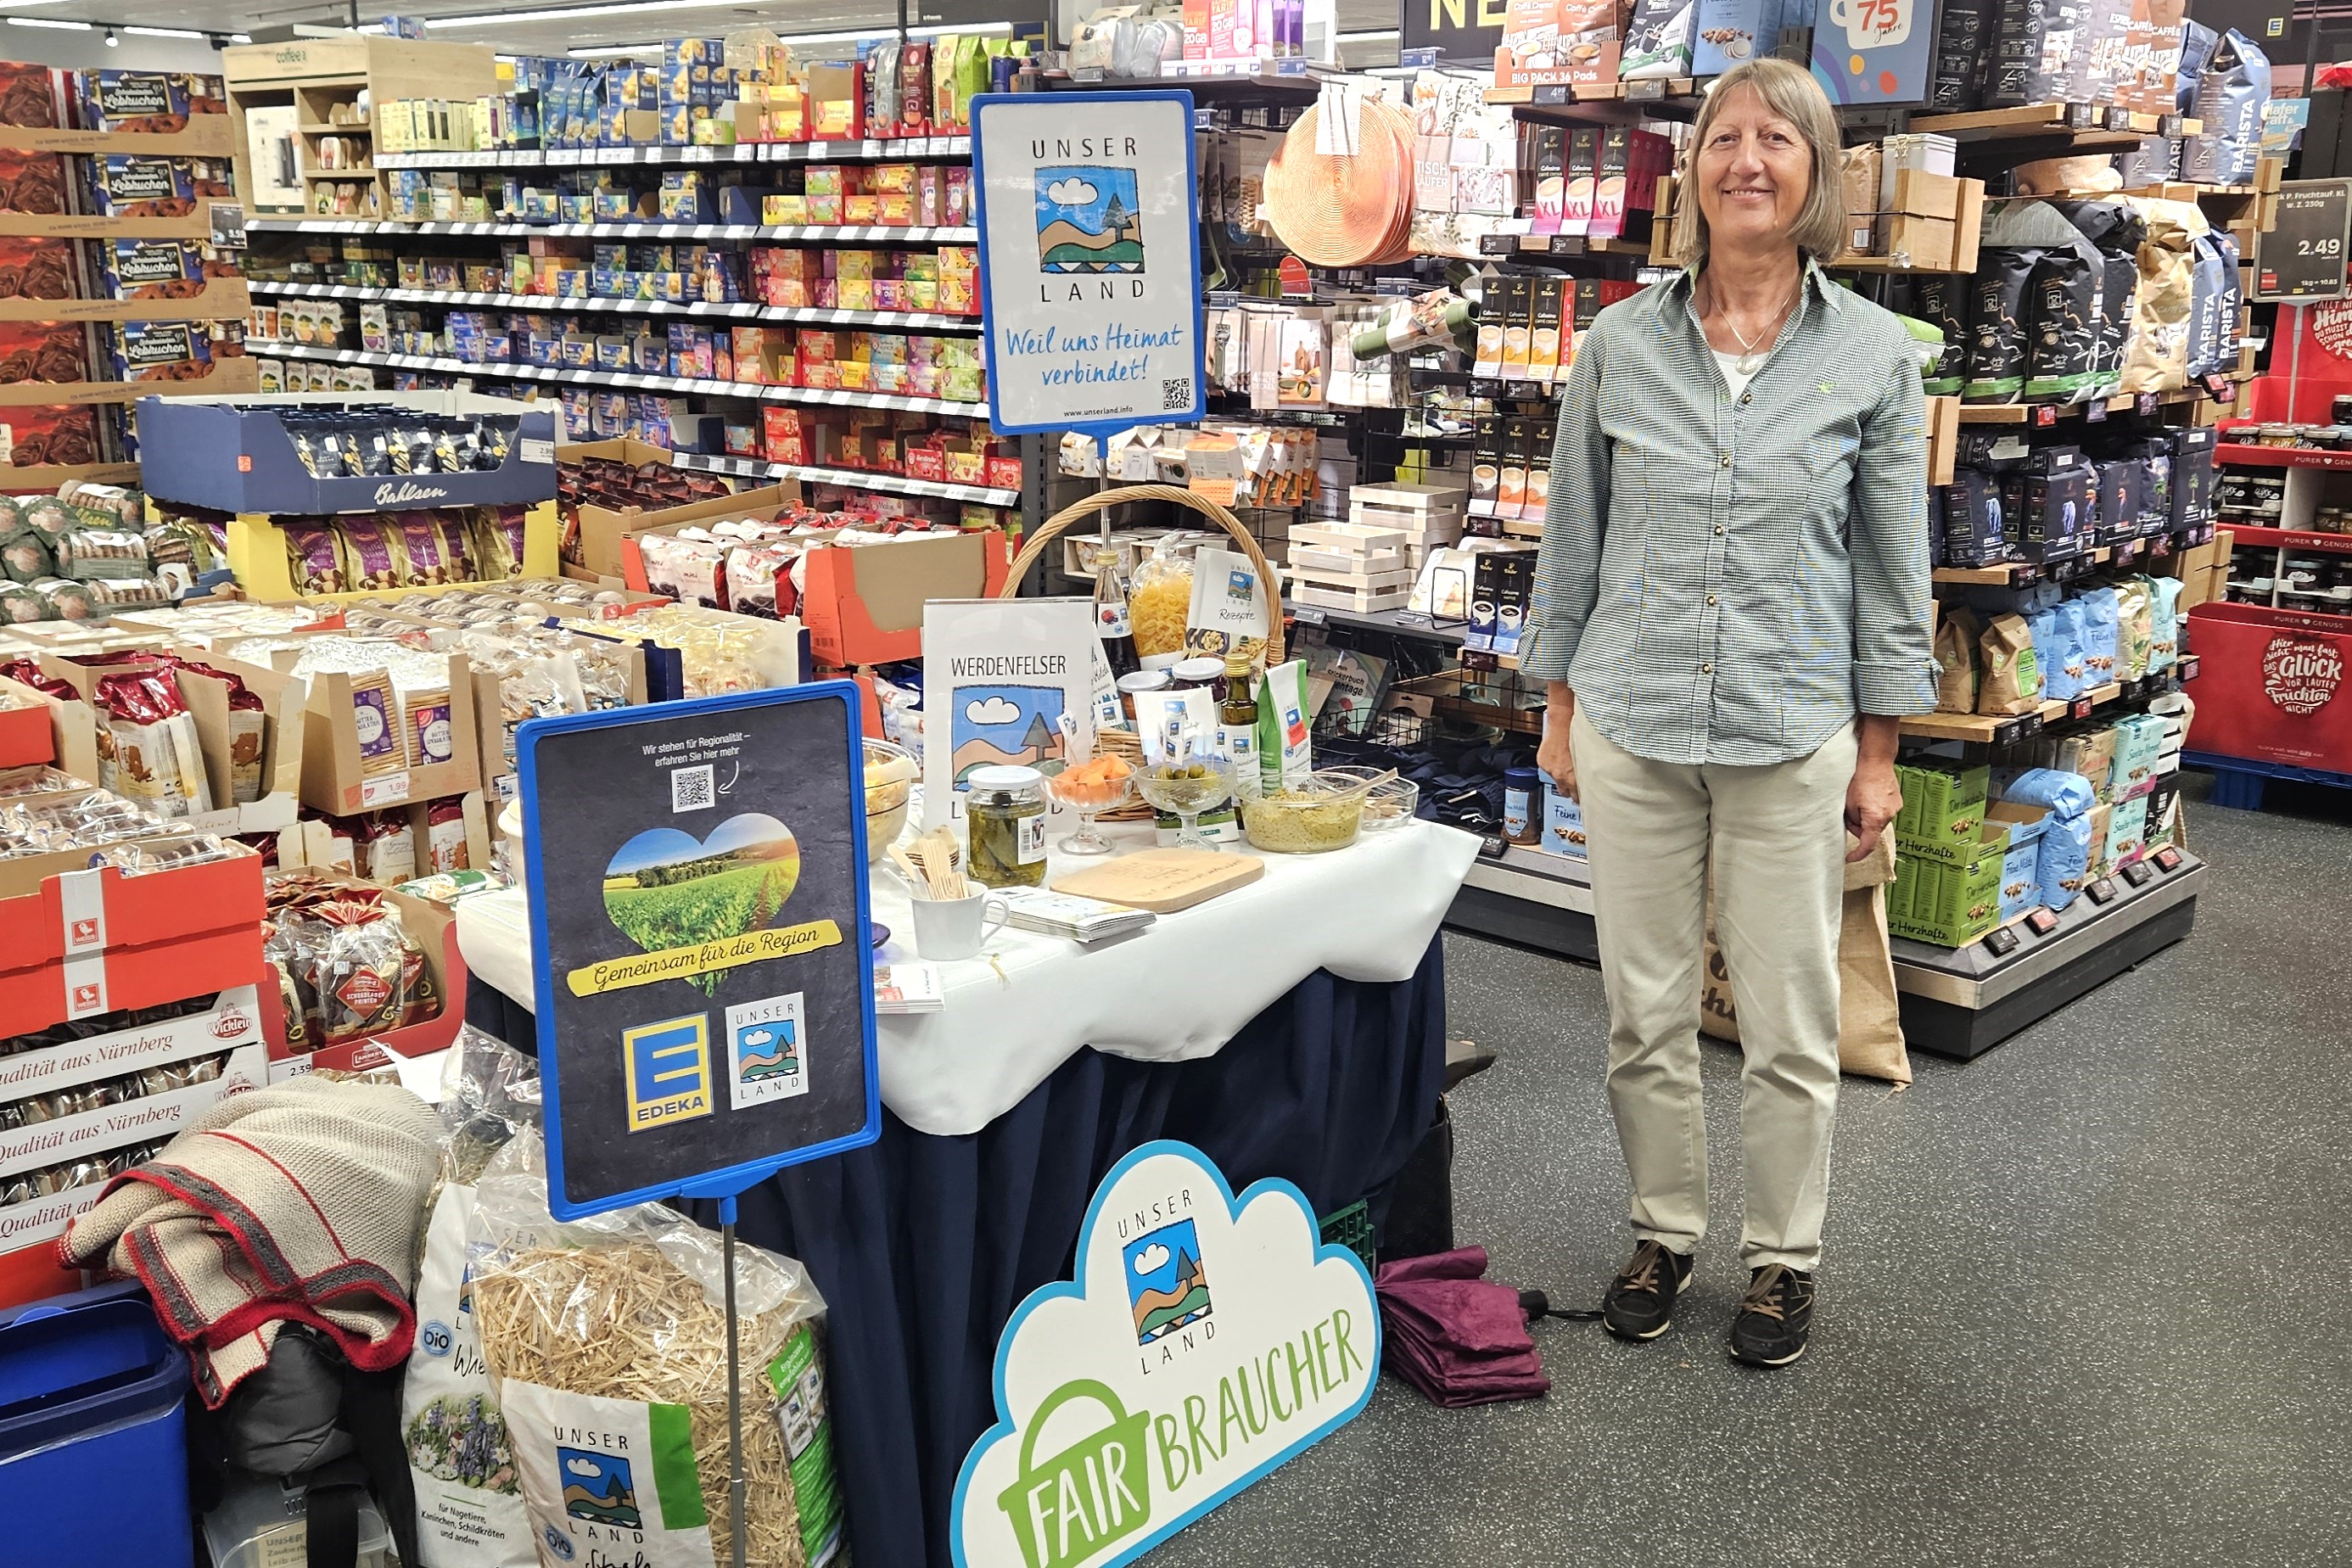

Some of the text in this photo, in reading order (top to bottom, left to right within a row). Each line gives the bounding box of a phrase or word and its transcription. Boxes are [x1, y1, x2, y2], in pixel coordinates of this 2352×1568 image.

[1857, 0, 1899, 31] 75
[1874, 23, 1903, 43] Jahre
[1511, 70, 1598, 84] BIG PACK 36 Pads
[104, 92, 165, 109] Lebkuchen
[2231, 98, 2255, 173] BARISTA
[1032, 137, 1137, 160] UNSER
[1415, 160, 1448, 176] TISCH
[110, 177, 170, 194] Lebkuchen
[1539, 200, 1560, 216] XL
[1569, 200, 1590, 216] XL
[1599, 200, 1621, 216] XL
[2298, 238, 2340, 256] 2.49
[120, 261, 178, 277] Lebkuchen
[1040, 278, 1145, 303] LAND
[2198, 292, 2216, 366] BARISTA
[2219, 287, 2237, 359] BARISTA
[1005, 322, 1184, 357] Weil uns Heimat
[128, 343, 187, 360] Lebkuchen
[1041, 355, 1148, 386] verbindet!
[1063, 406, 1134, 417] www.unserland.info
[2295, 456, 2321, 464] PURER
[374, 481, 447, 505] Bahlsen
[1218, 608, 1256, 627] Rezepte
[2274, 615, 2344, 629] PURER GENUSS
[2269, 638, 2293, 651] Hier
[2316, 644, 2338, 659] fast
[951, 655, 1067, 677] WERDENFELSER
[2264, 654, 2343, 680] DAS GLÜCK
[1335, 680, 1364, 696] entage
[2285, 679, 2337, 690] VOR LAUTER
[2286, 706, 2315, 714] NICHT
[642, 745, 658, 755] Wir
[658, 742, 685, 753] stehen
[686, 739, 697, 749] für
[698, 732, 743, 748] Regionalität
[655, 747, 740, 767] erfahren Sie hier mehr
[389, 781, 406, 792] 1.99
[951, 801, 1063, 820] LD
[1554, 804, 1576, 820] Feine
[1905, 838, 1956, 860] Herzhafte
[1898, 919, 1949, 939] Herzhafte
[594, 927, 820, 991] Gemeinsam für die Region
[346, 991, 385, 1000] SCHOKOLADEN
[736, 1003, 795, 1025] UNSER
[207, 1016, 252, 1037] Wicklein
[0, 1034, 174, 1086] ualität aus Nürnberg
[289, 1063, 311, 1077] 2.39
[740, 1078, 799, 1100] LAND
[637, 1095, 704, 1123] EDEKA
[70, 1123, 100, 1142] aus
[104, 1104, 182, 1134] Nürnberg
[1, 1198, 95, 1237] Qualität au
[1117, 1188, 1194, 1240] UNSER
[423, 1327, 450, 1350] bio
[1140, 1320, 1217, 1376] LAND
[554, 1426, 629, 1450] UNSER
[1026, 1308, 1364, 1568] FAIR BRAUCHER
[438, 1503, 487, 1525] für Nagetiere,
[422, 1510, 506, 1540] Kaninchen, Schildkröten
[568, 1520, 644, 1545] LAND
[266, 1534, 303, 1547] UNSER
[440, 1529, 479, 1548] und andere
[545, 1530, 571, 1554] bio
[267, 1545, 306, 1557] Zauberh
